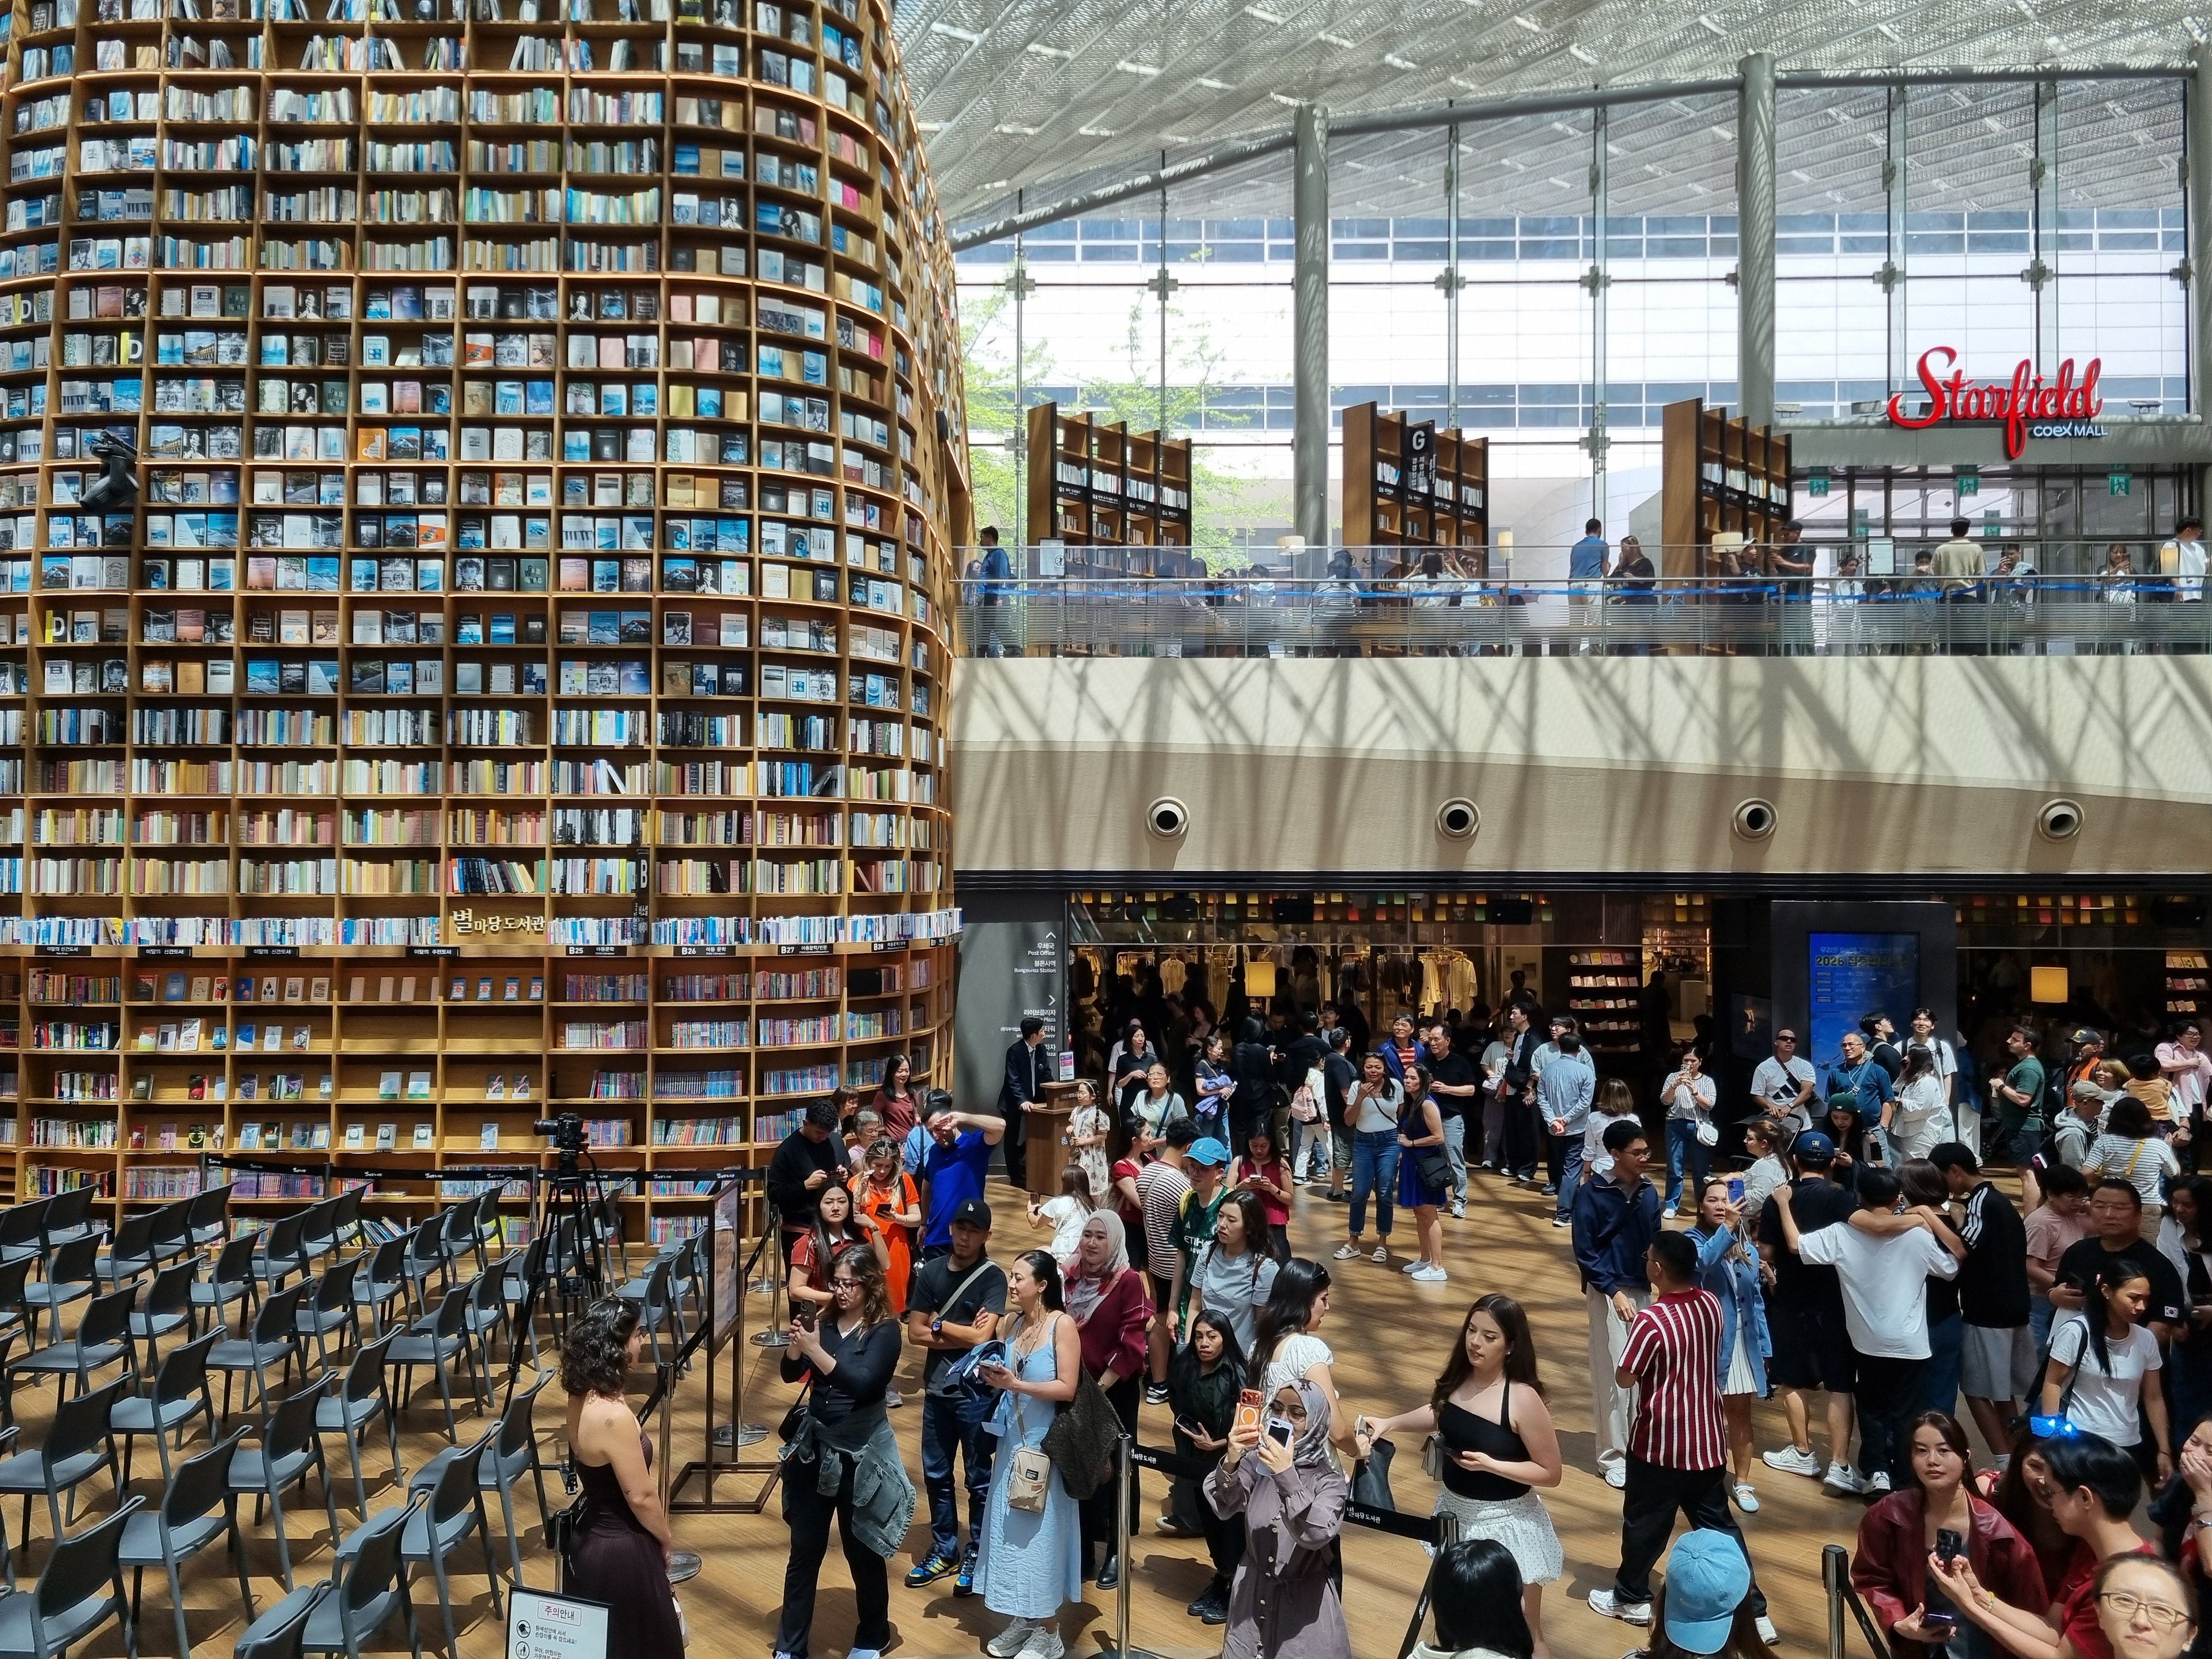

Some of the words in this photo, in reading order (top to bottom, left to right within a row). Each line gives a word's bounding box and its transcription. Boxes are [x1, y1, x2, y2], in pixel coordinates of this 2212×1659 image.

[1887, 346, 2103, 459] Starfield
[2074, 425, 2108, 437] MALL
[1412, 431, 1425, 450] G
[641, 859, 647, 888] B
[681, 947, 696, 955] B26
[1184, 1235, 1204, 1247] ETIH
[544, 1605, 574, 1620] 주의안내
